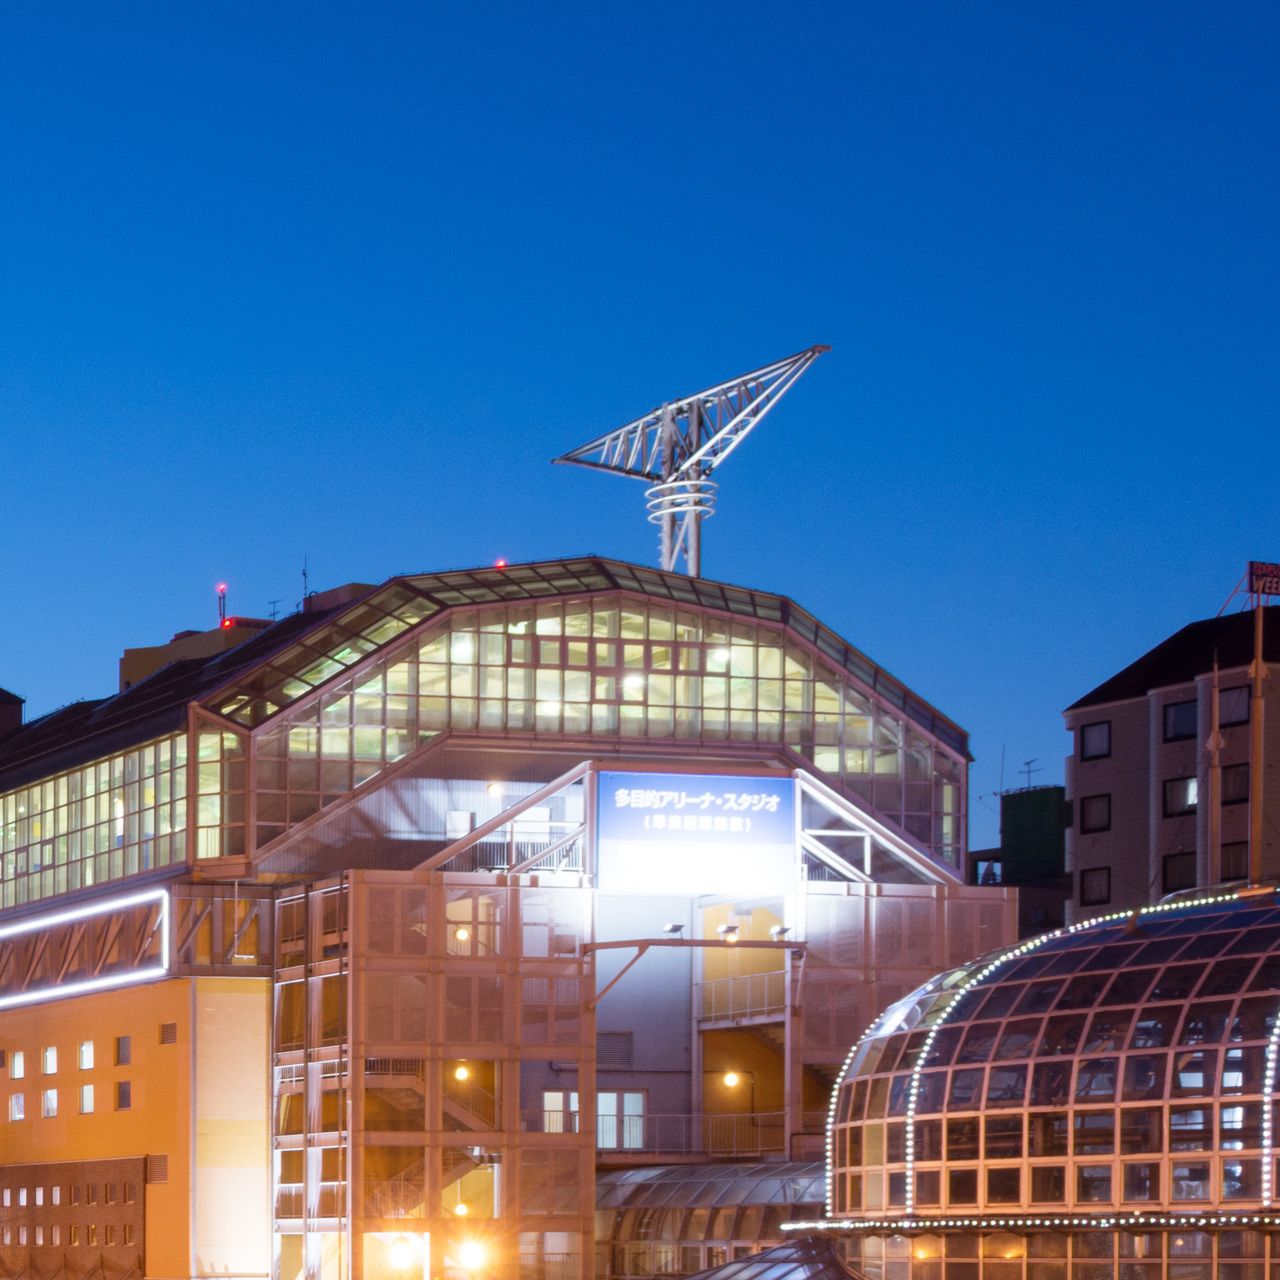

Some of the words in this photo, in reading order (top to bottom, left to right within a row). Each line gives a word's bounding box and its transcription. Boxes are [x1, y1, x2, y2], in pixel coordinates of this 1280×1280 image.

[615, 789, 780, 812] 多目的アリーナ・スタジオ
